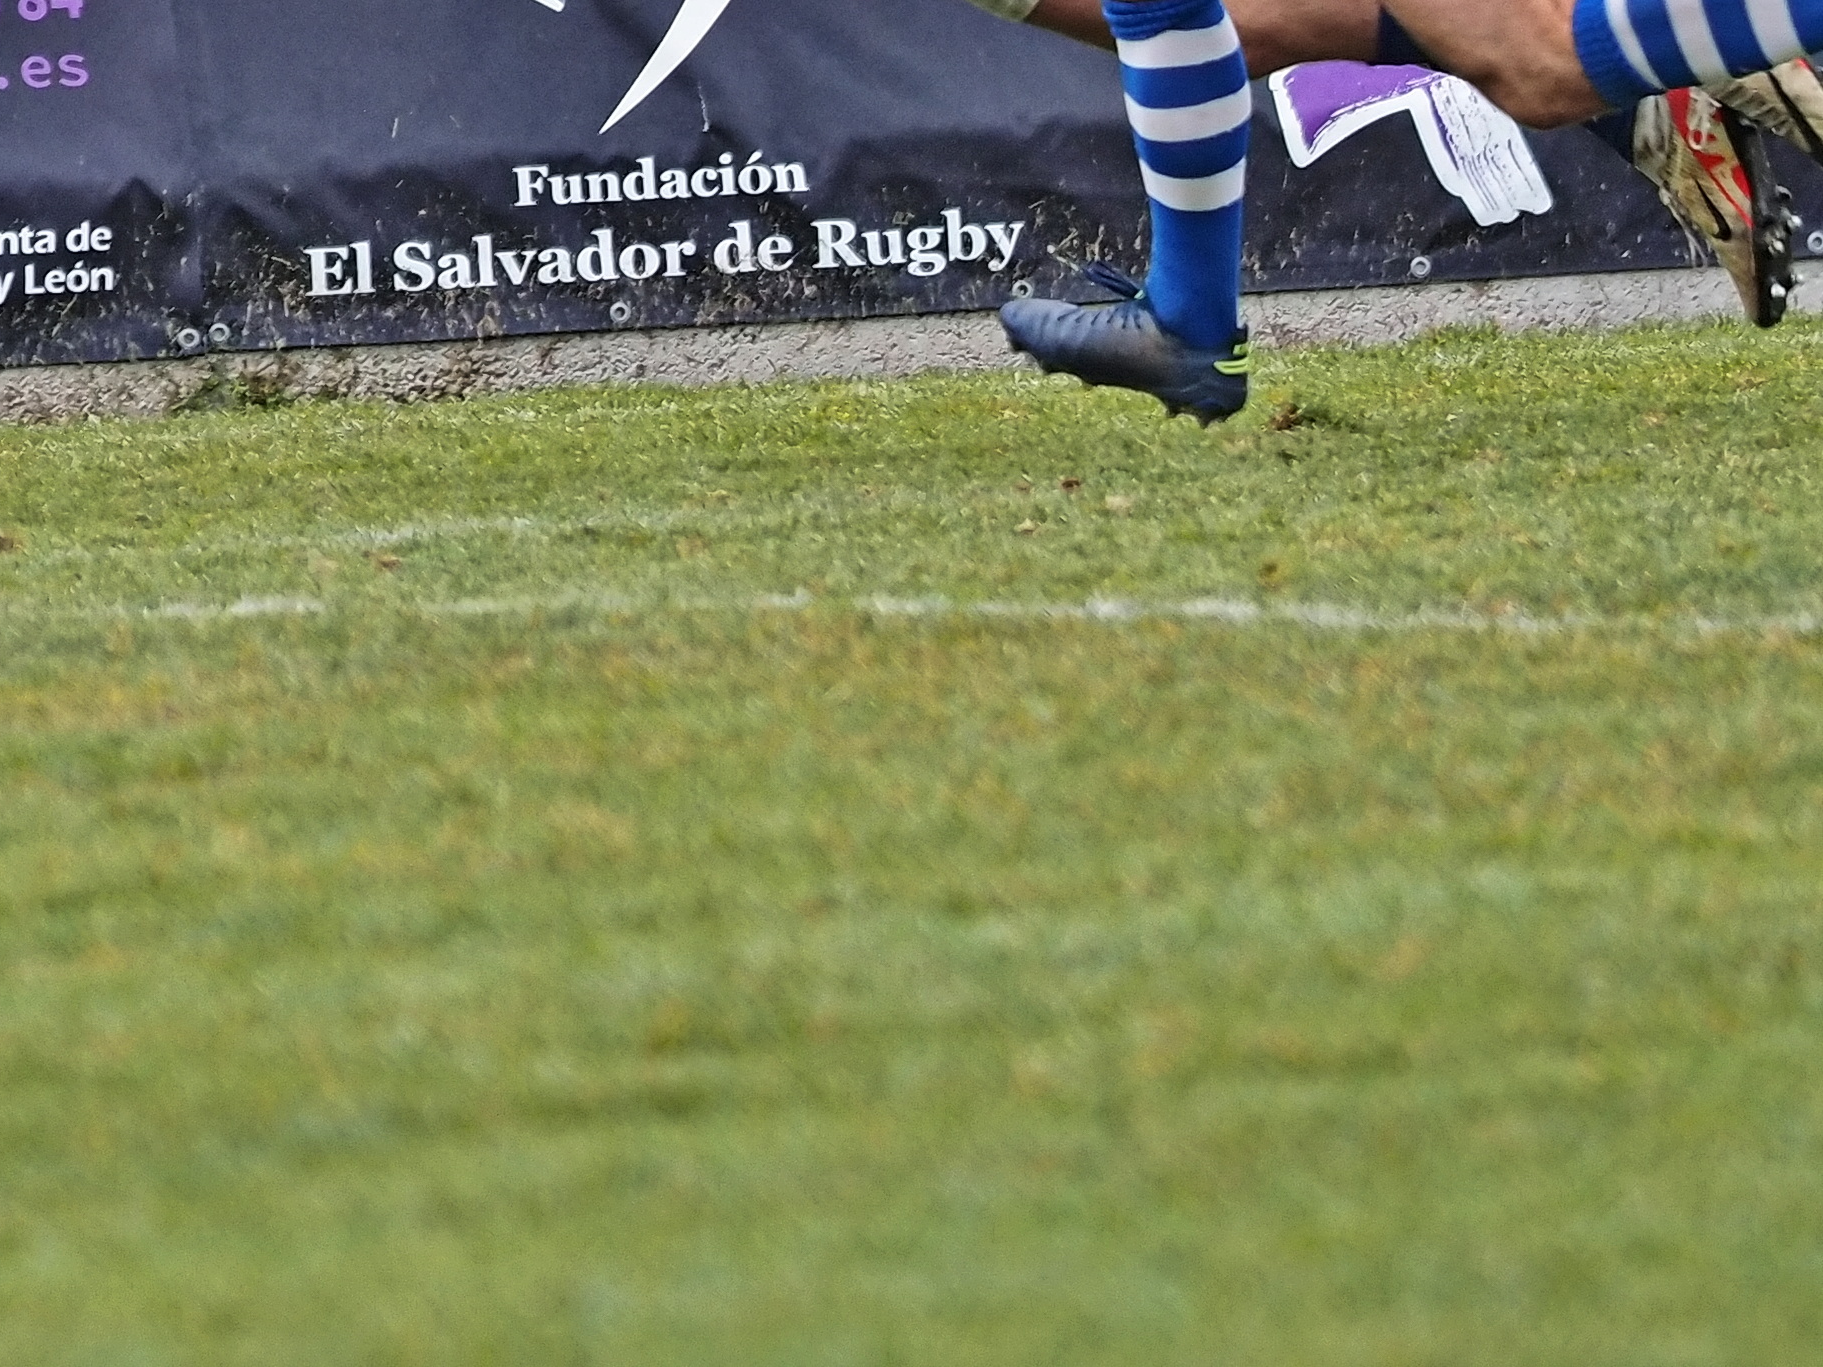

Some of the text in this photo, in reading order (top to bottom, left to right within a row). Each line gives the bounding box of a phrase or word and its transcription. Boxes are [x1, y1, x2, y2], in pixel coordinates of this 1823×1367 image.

[513, 150, 810, 207] Fundación
[65, 220, 113, 253] de
[304, 208, 1025, 297] El Salvador de Rugby
[24, 260, 114, 295] León
